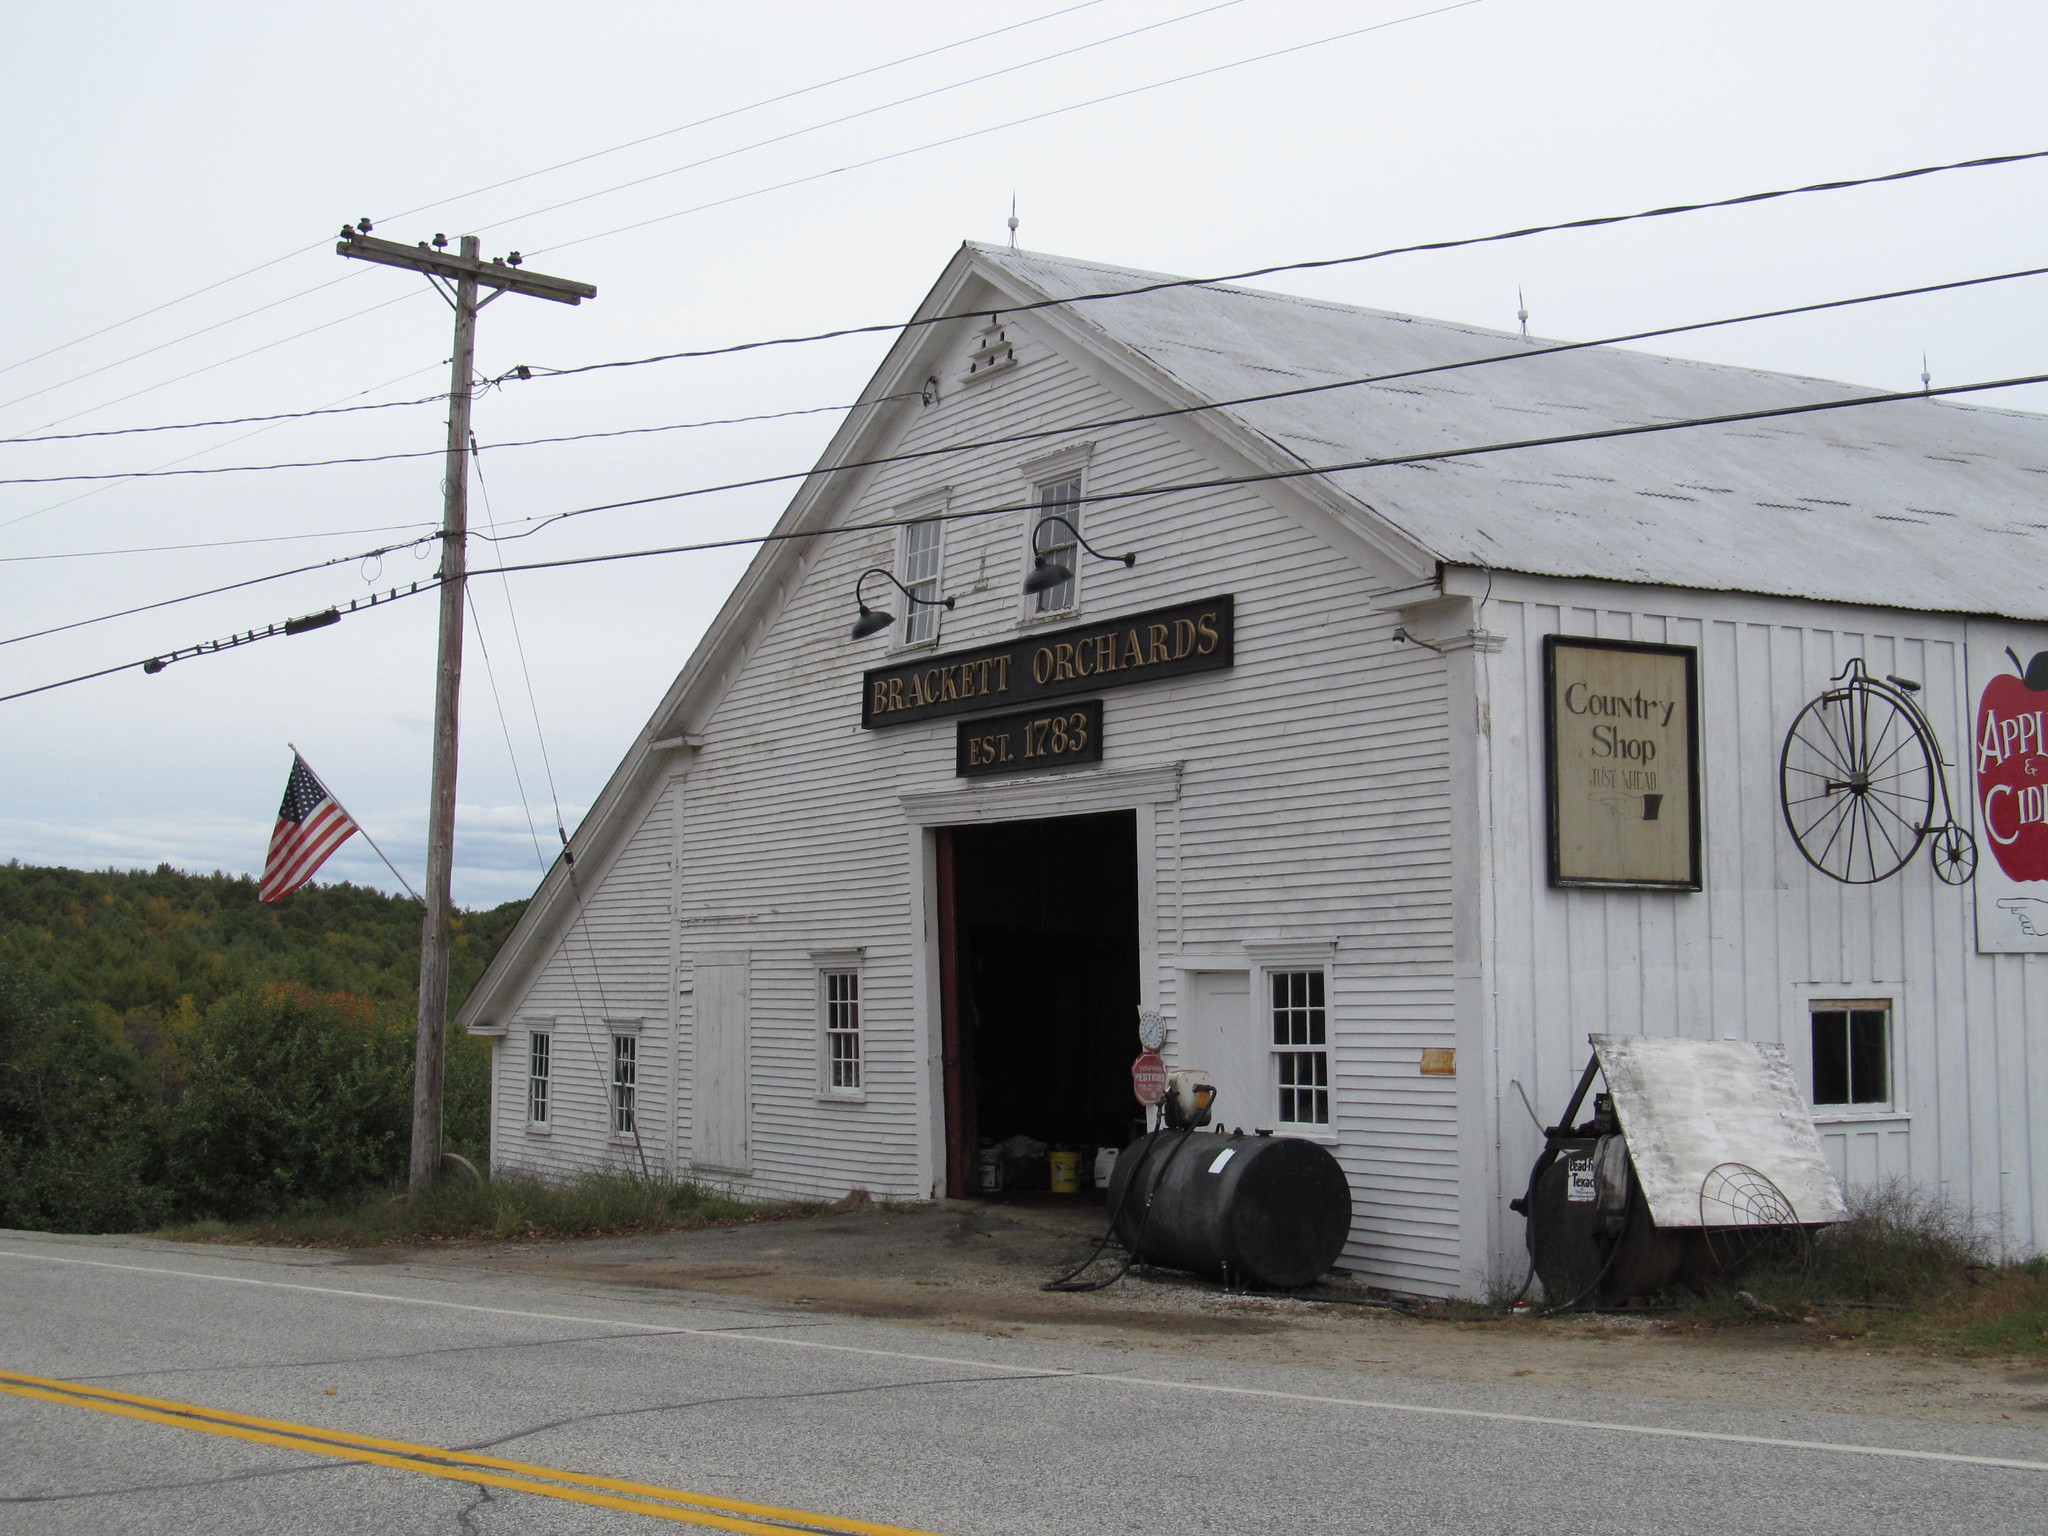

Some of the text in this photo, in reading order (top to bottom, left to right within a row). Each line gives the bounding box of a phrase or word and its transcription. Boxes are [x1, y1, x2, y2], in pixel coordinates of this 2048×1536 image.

[871, 612, 1219, 715] BRACKETT ORCHARDS
[969, 712, 1088, 766] EST. 1783
[1591, 724, 1656, 766] Shop
[1978, 709, 2048, 774] APPL
[1590, 768, 1657, 790] JUST AHEAD
[2024, 758, 2038, 776] &
[1572, 1172, 1595, 1187] Texac
